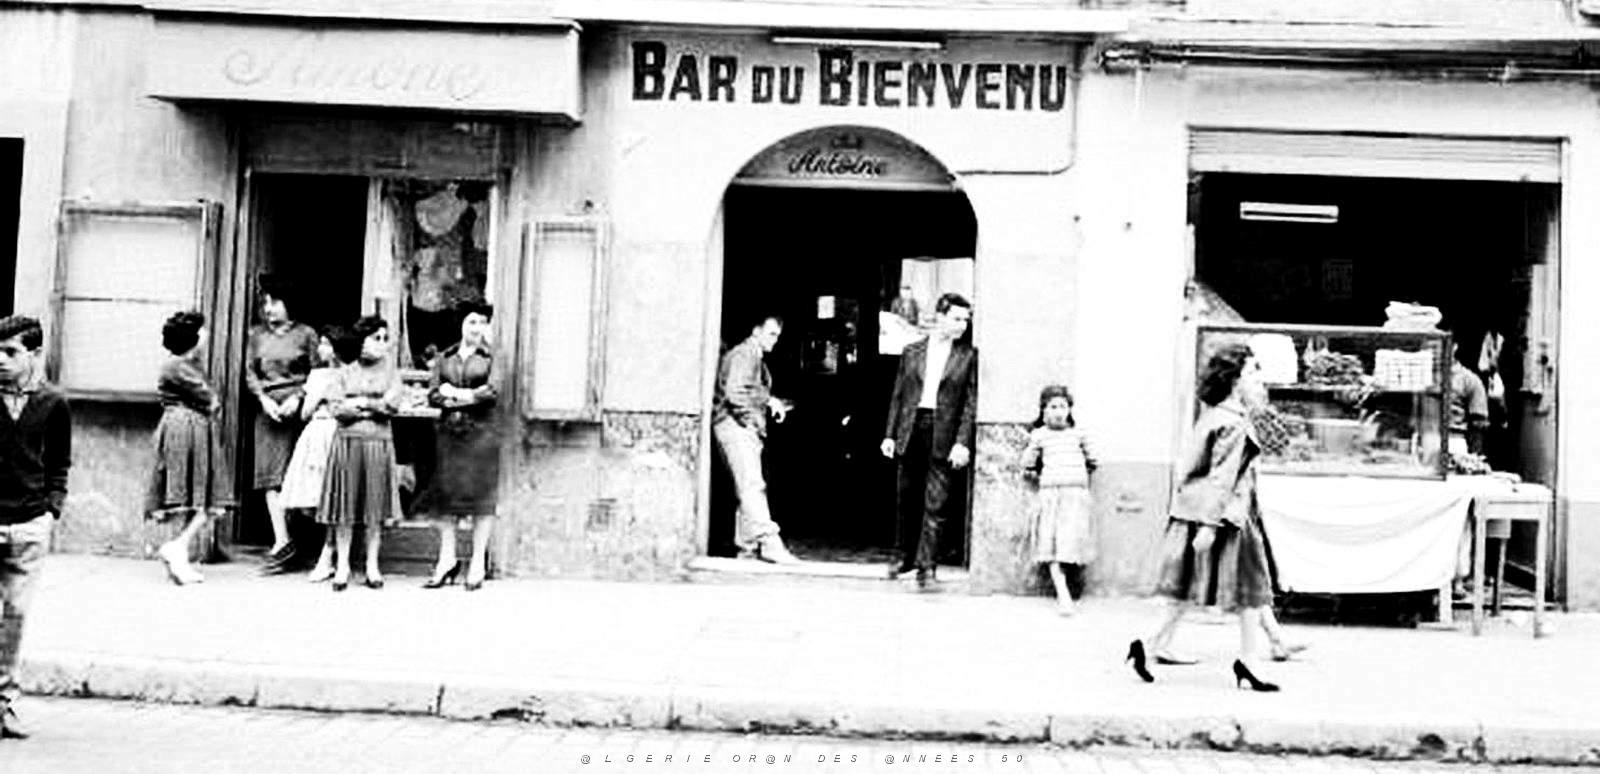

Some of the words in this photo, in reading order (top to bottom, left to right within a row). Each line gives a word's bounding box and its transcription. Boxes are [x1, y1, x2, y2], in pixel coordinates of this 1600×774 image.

[632, 41, 737, 102] BAR
[752, 65, 804, 104] DU
[818, 48, 1067, 111] BIENVENU
